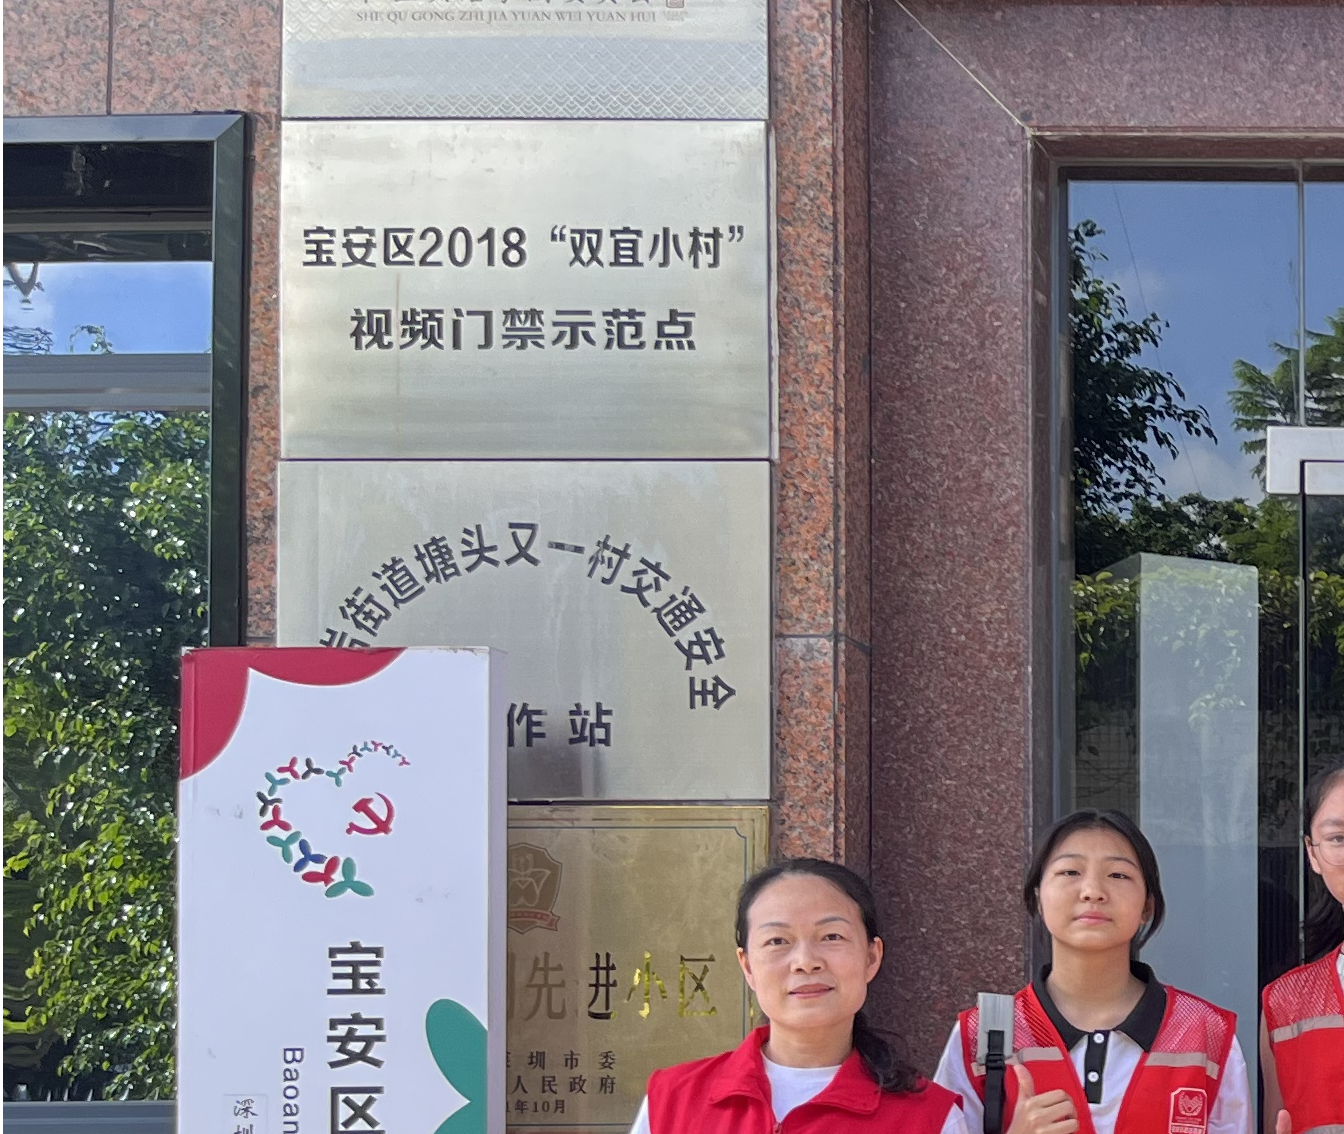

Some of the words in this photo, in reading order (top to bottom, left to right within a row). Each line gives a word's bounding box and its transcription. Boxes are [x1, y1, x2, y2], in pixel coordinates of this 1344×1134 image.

[349, 307, 697, 352] 视频门禁示范点
